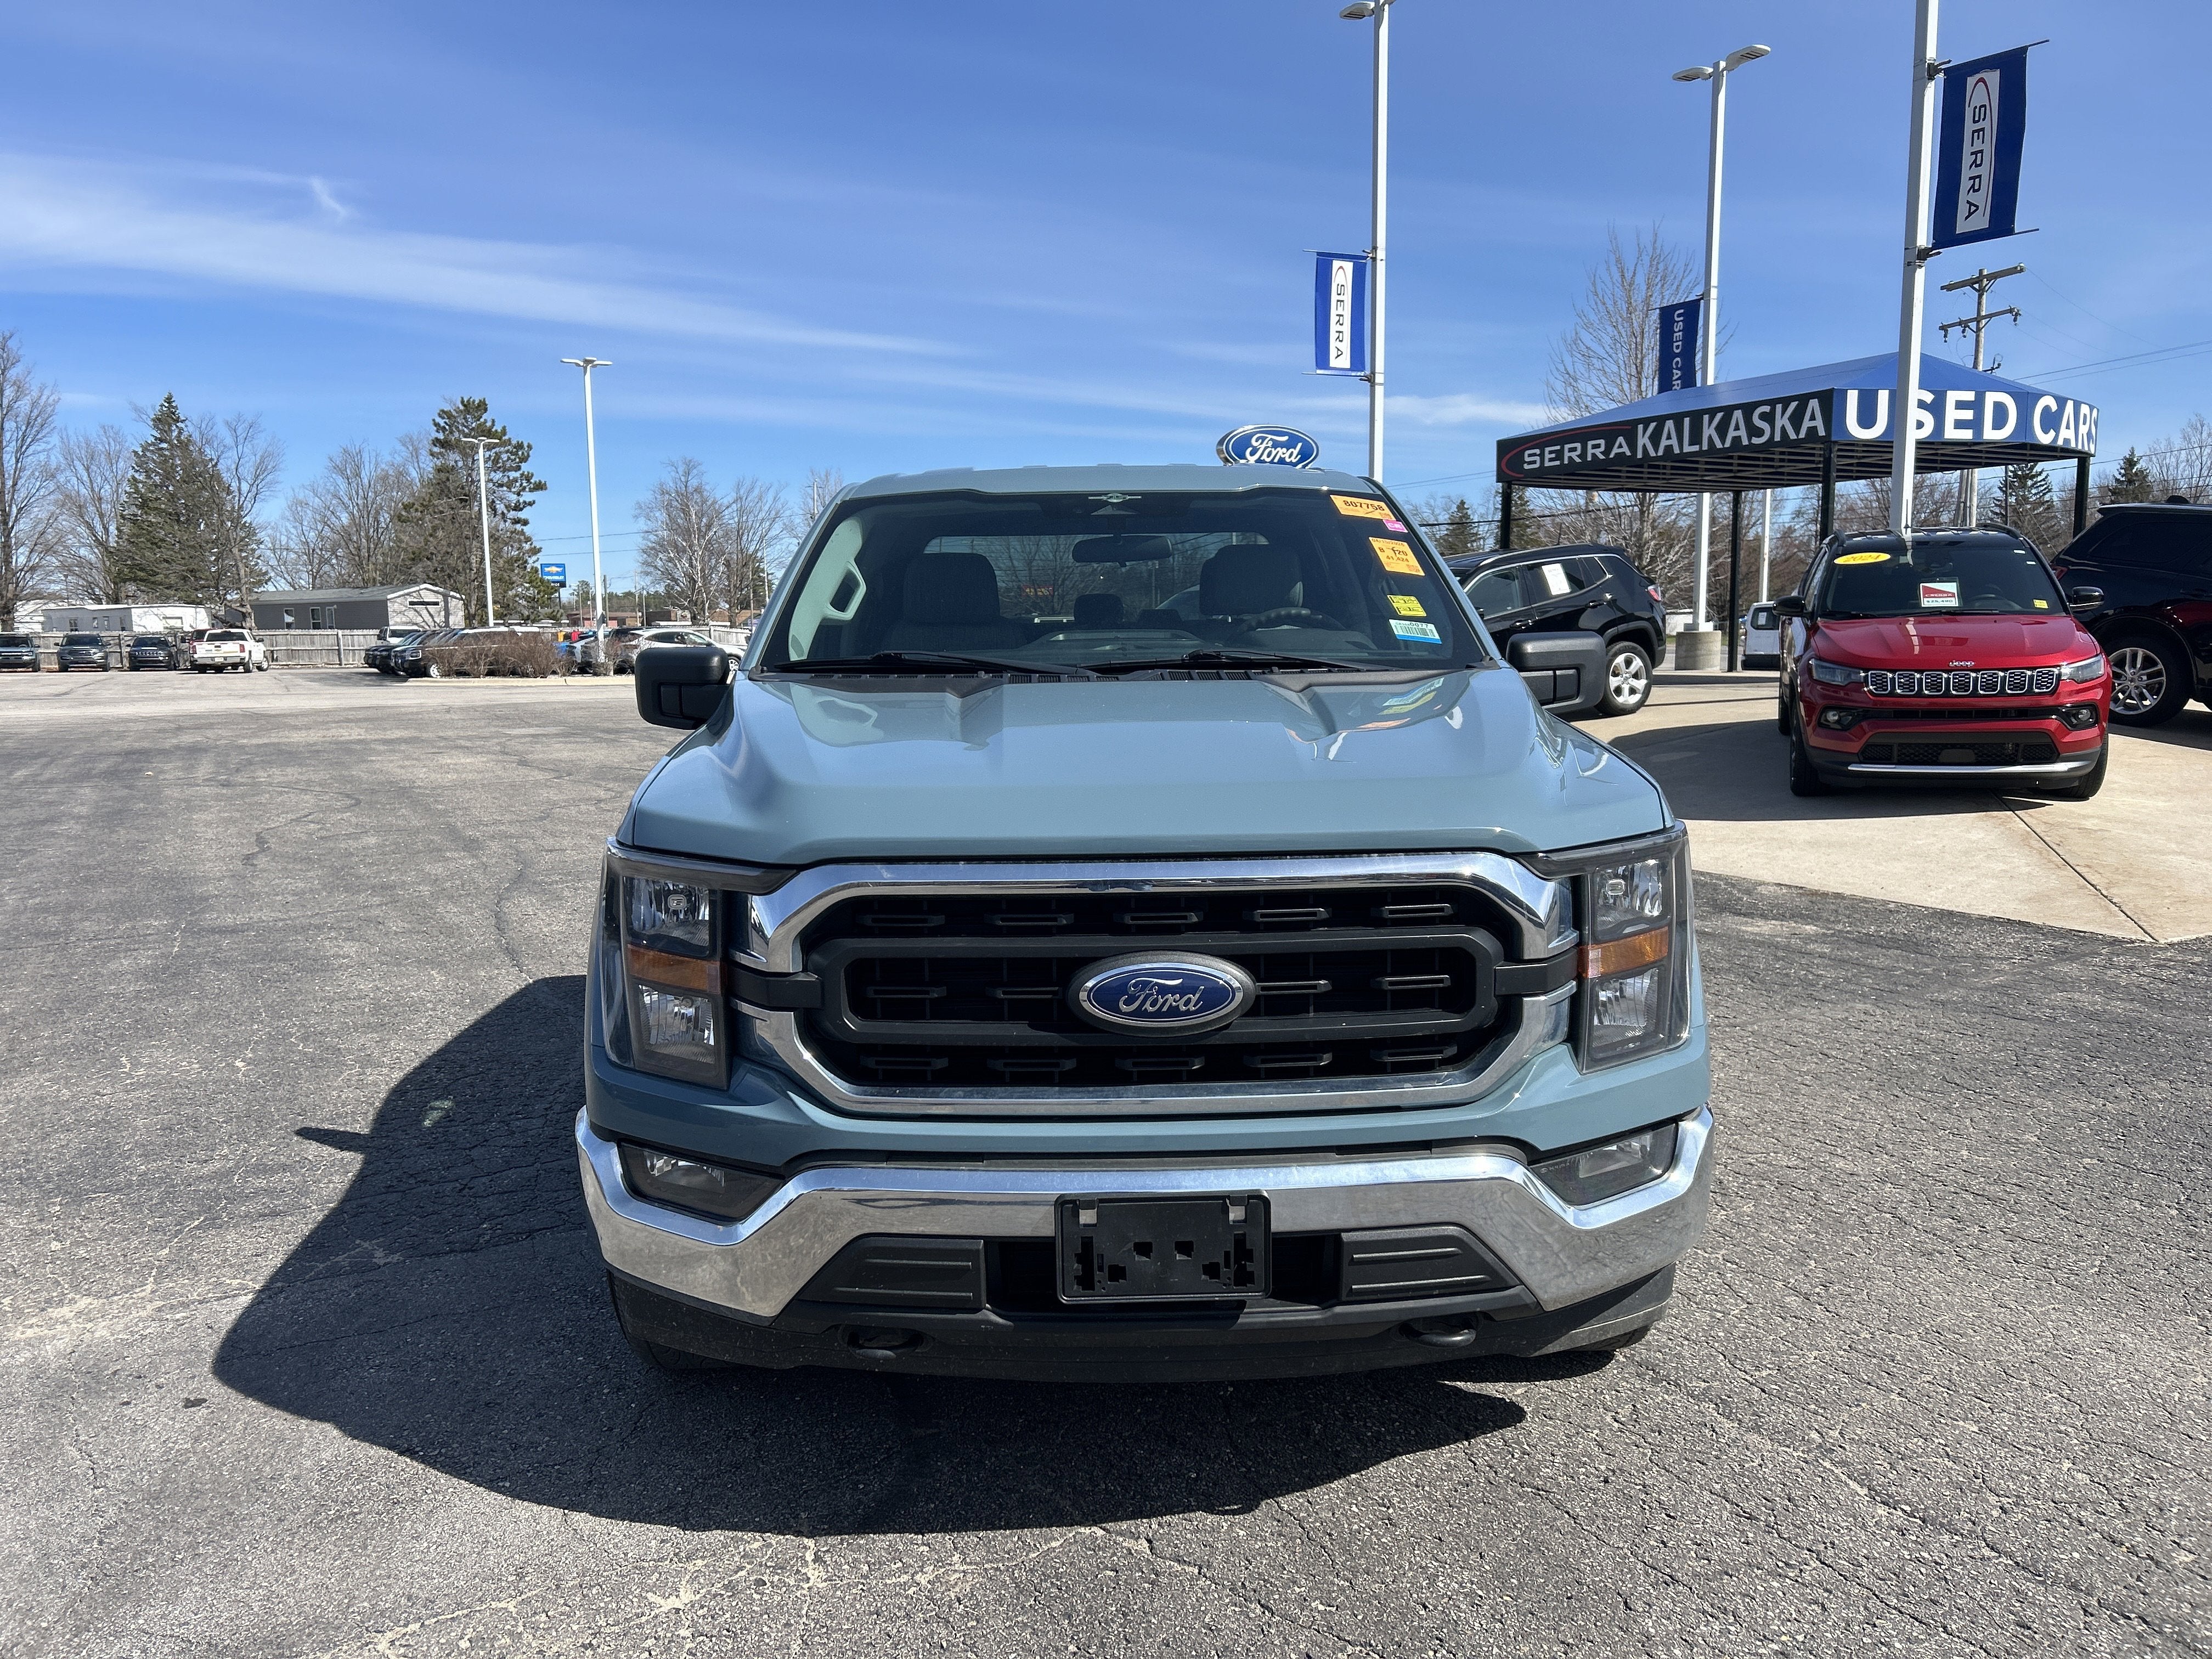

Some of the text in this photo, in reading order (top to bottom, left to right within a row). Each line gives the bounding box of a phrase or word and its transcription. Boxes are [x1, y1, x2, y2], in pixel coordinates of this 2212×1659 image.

[1965, 103, 1987, 221] SERRA
[1335, 283, 1345, 359] SERRA
[1672, 308, 1684, 391] USED CAR
[1245, 433, 1303, 464] Ford
[1522, 398, 1826, 470] SERRA KALKASKA
[1846, 389, 2098, 455] USED CARS
[1342, 500, 1385, 511] 807758
[1949, 659, 1975, 668] Jeep
[1119, 977, 1205, 1013] Ford
